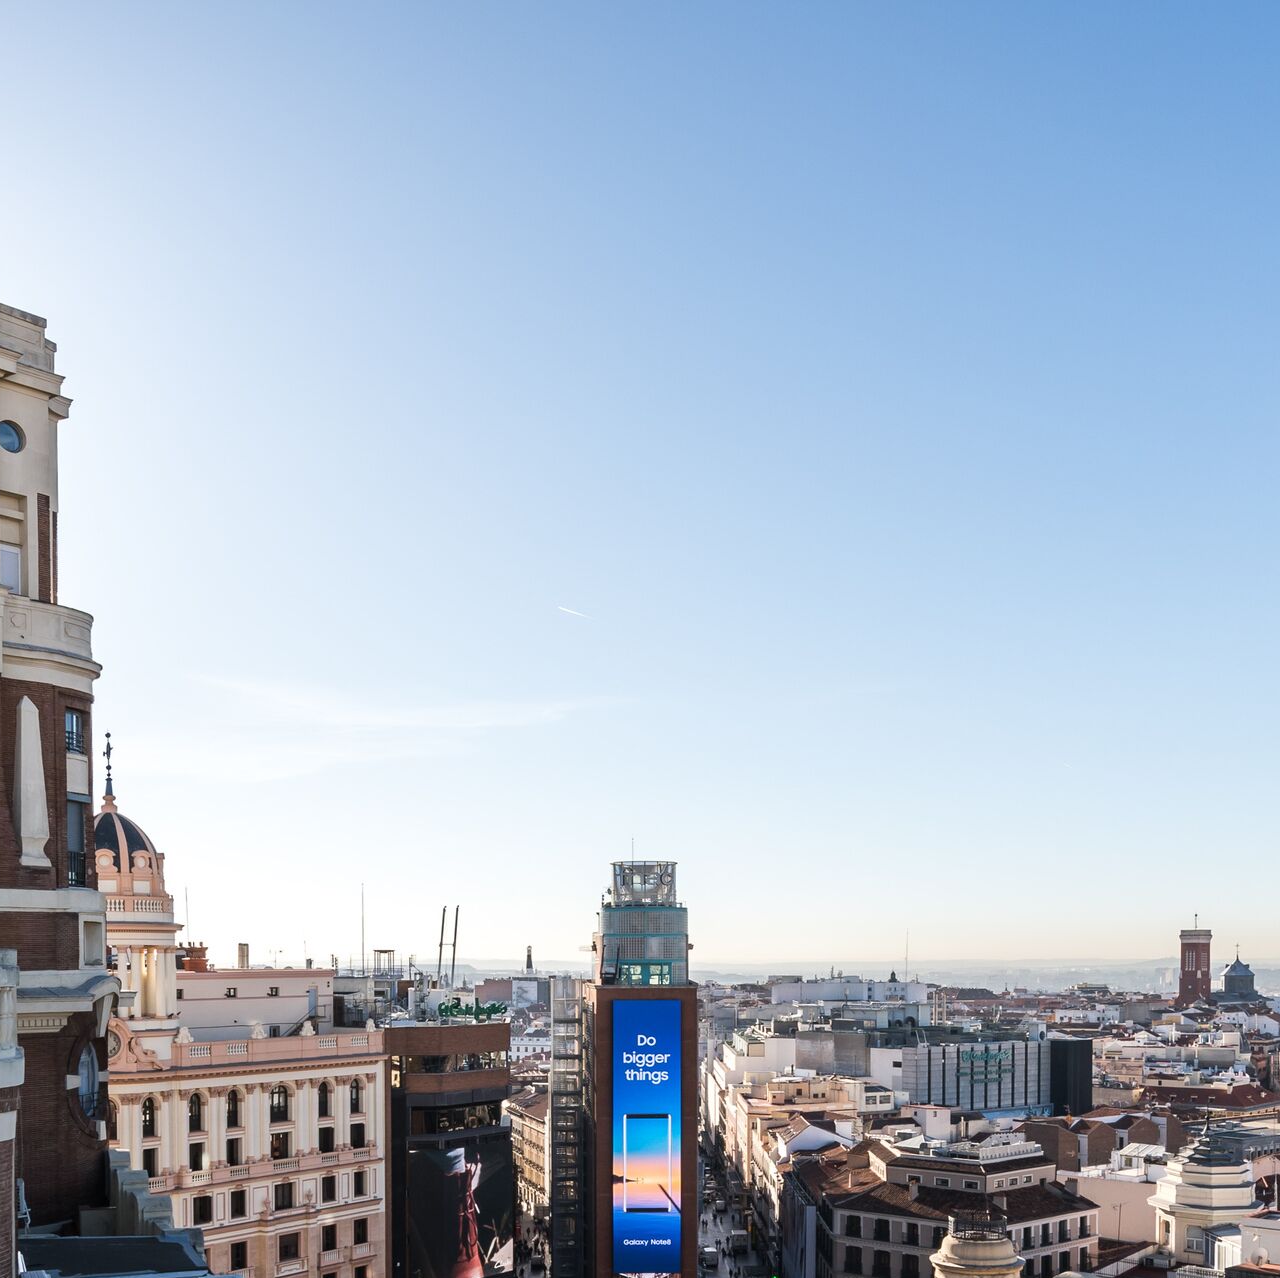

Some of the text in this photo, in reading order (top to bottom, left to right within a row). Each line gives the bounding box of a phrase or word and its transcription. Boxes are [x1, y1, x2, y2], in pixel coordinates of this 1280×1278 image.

[637, 1034, 656, 1046] Do
[623, 1051, 671, 1067] bigger
[625, 1068, 669, 1085] things
